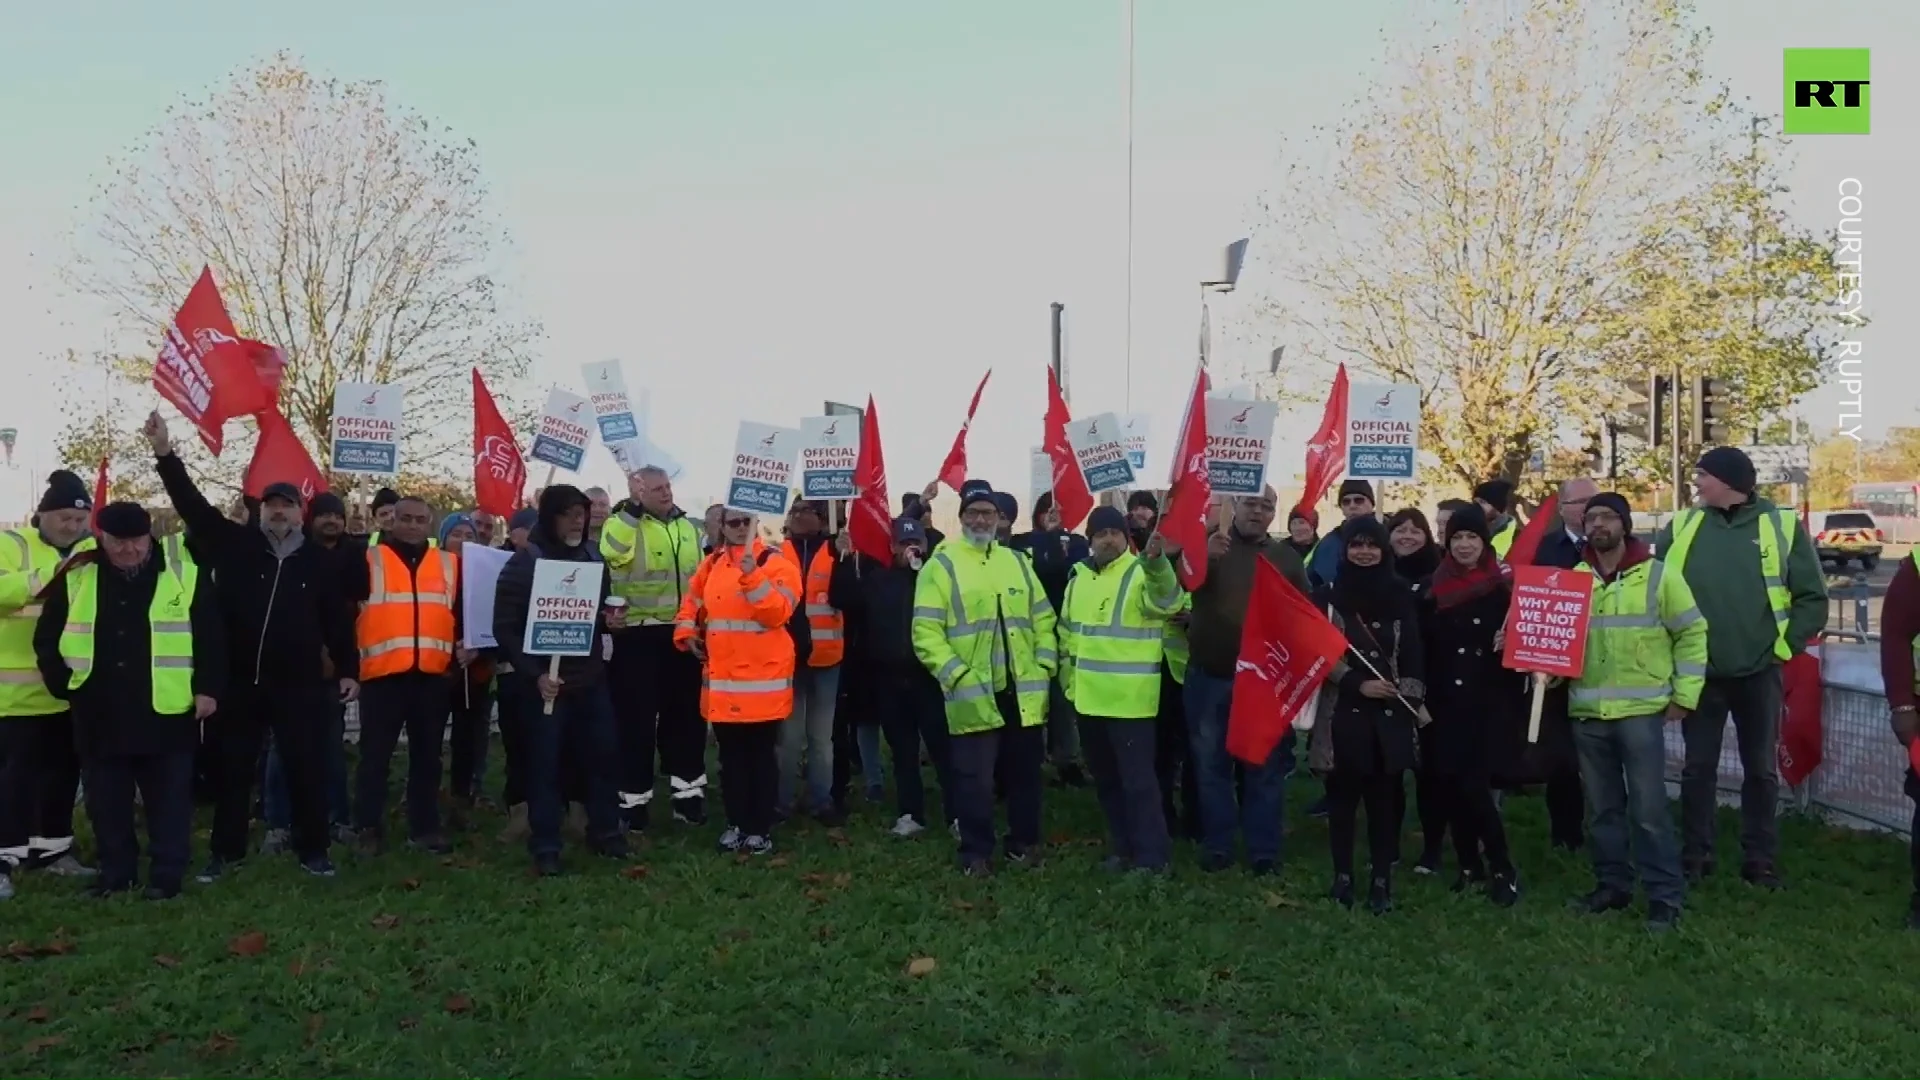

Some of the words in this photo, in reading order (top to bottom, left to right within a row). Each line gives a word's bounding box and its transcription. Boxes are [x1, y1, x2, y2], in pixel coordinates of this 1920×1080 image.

[337, 416, 396, 430] OFFICIAL
[544, 416, 588, 438] OFFICIAL
[1351, 420, 1413, 432] OFFICIAL
[338, 428, 393, 442] DISPUTE
[542, 426, 585, 445] DISPUTE
[1353, 433, 1410, 444] DISPUTE
[804, 447, 856, 458] OFFICIAL
[1077, 440, 1121, 457] OFFICIAL
[736, 453, 790, 472] OFFICIAL
[806, 458, 854, 469] DISPUTE
[1354, 461, 1408, 471] CONDITIONS
[736, 466, 788, 484] DISPUTE
[536, 597, 595, 609] OFFICIAL
[1517, 596, 1551, 609] WHY
[1554, 601, 1582, 614] ARE
[537, 609, 591, 621] DISPUTE
[1520, 610, 1541, 622] WE
[1546, 613, 1577, 626] NOT
[1516, 621, 1576, 639] GETTING
[1521, 636, 1569, 651] 10.5%?
